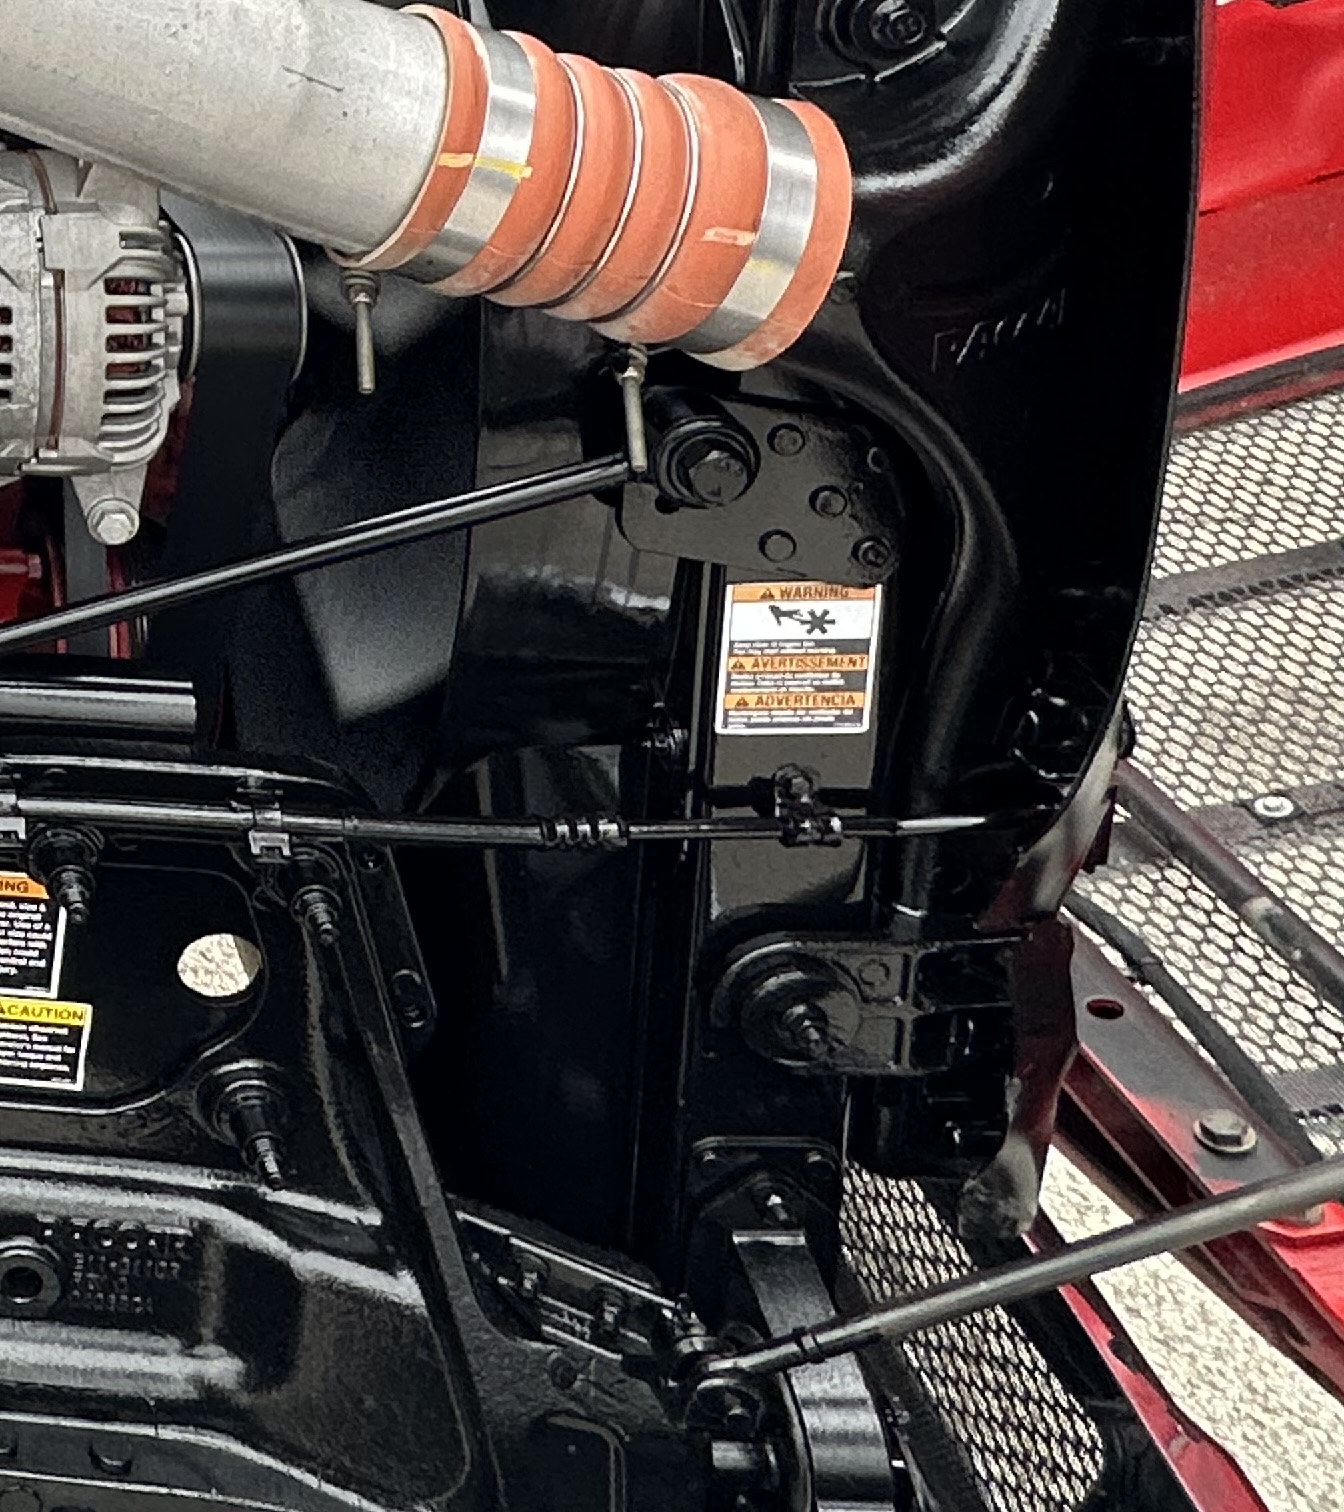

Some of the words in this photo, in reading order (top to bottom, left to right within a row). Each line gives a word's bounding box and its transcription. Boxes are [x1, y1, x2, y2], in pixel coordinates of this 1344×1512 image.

[778, 584, 850, 599] WARNING
[750, 655, 867, 670] AVERTISSEMENT
[754, 694, 856, 707] ADVERTENCIA
[6, 1003, 84, 1022] CAUTION
[35, 1213, 195, 1261] PACCAR
